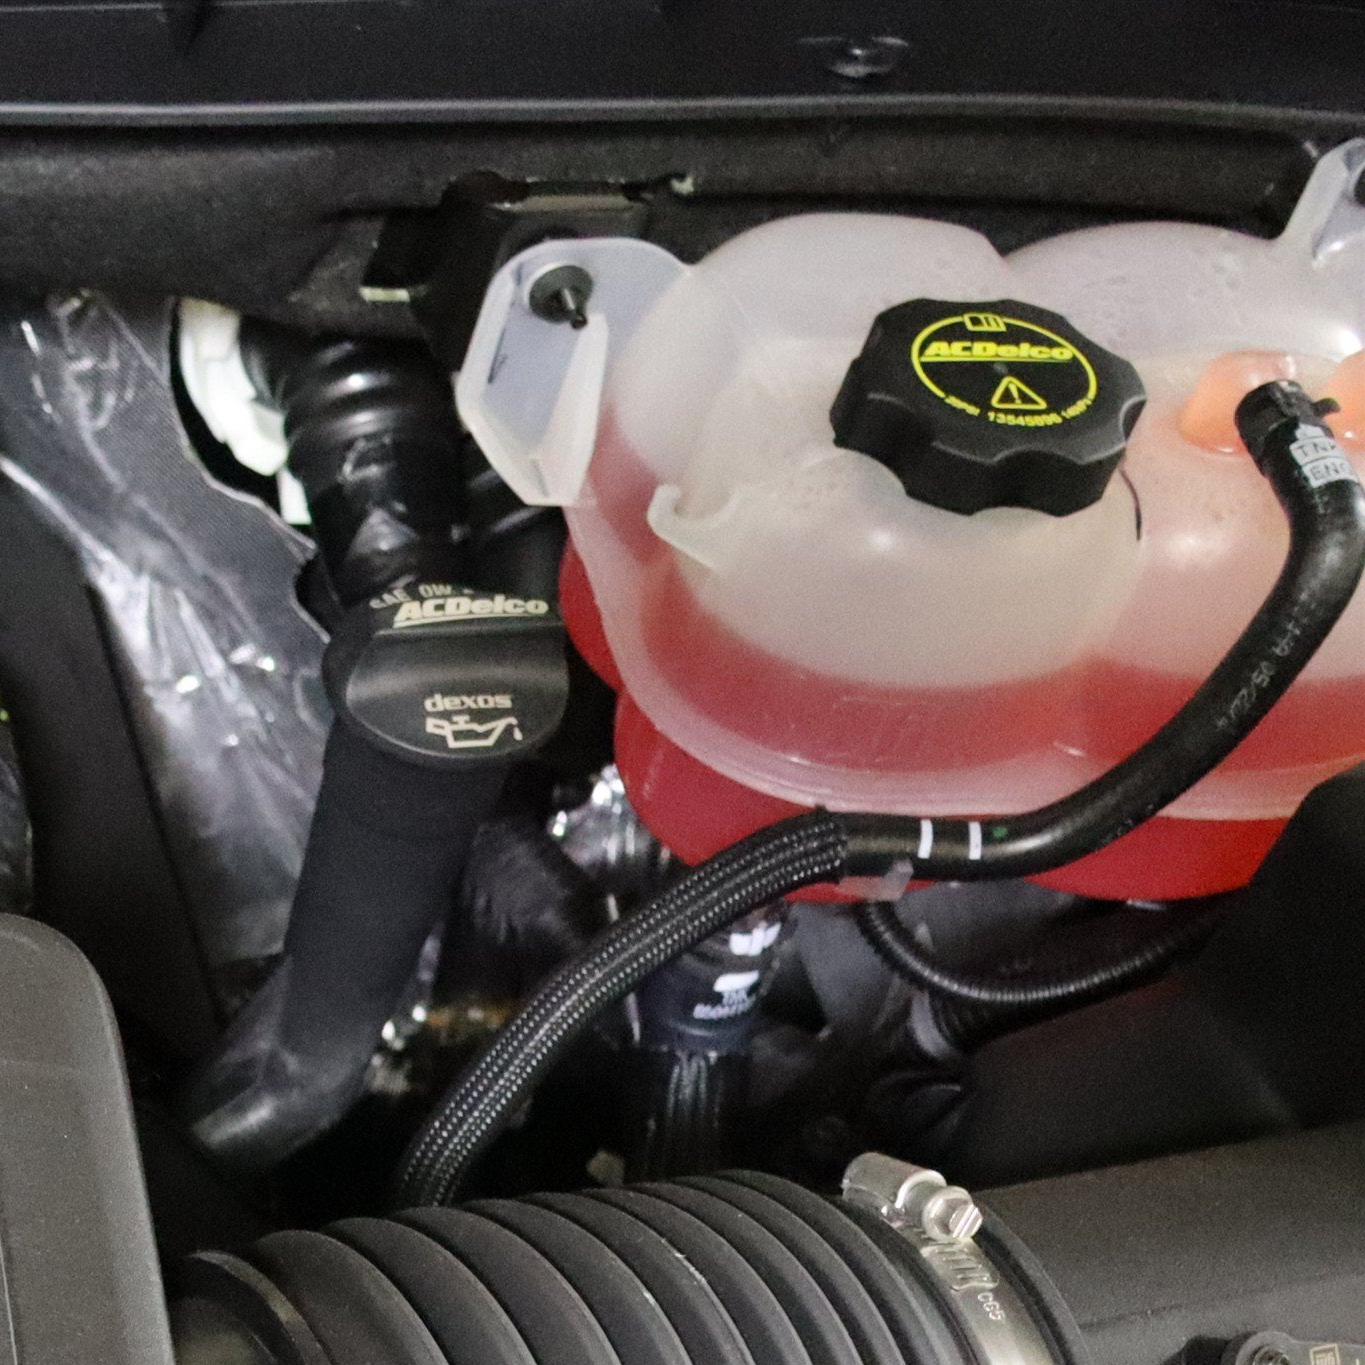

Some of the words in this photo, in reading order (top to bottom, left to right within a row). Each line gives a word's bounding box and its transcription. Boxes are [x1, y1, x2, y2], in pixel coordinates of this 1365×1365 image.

[921, 340, 1074, 362] ACDelco
[394, 594, 549, 627] ACDelco
[423, 692, 513, 712] dexos
